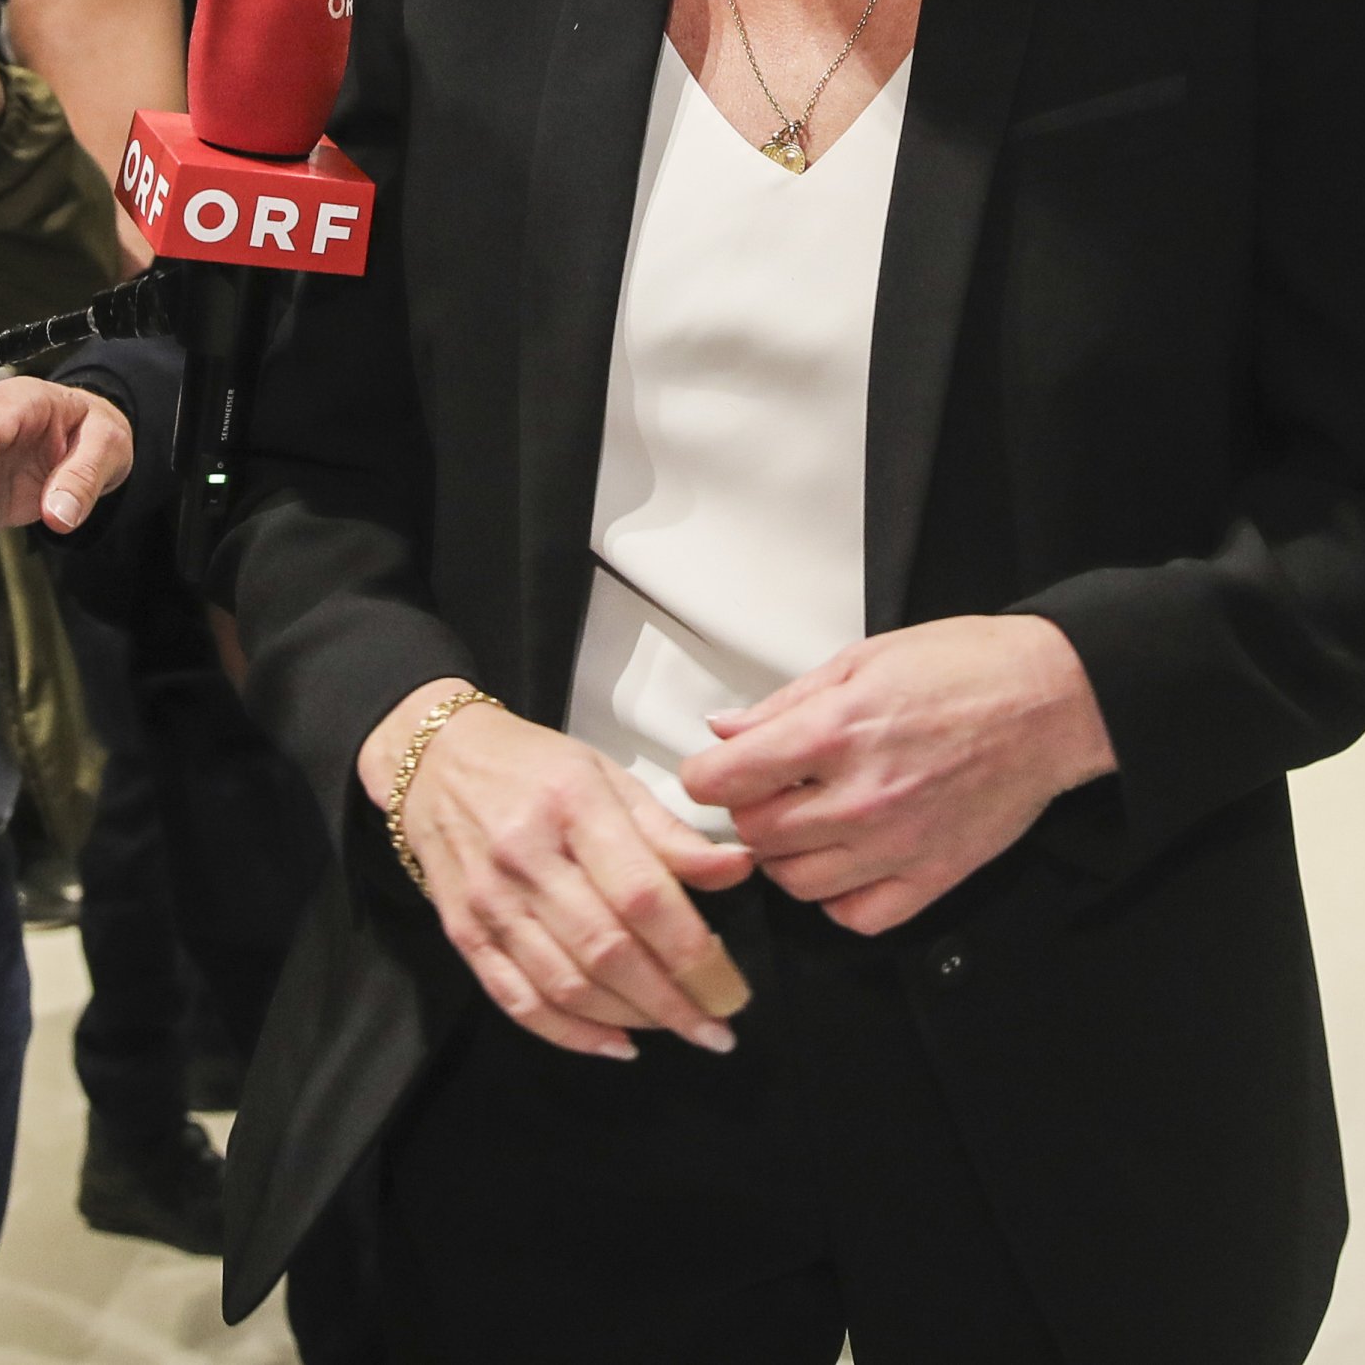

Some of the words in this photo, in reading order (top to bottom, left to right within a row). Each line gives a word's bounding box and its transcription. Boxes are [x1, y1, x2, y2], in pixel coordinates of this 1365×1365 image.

[123, 139, 170, 227] ORF
[183, 188, 360, 255] ORF
[221, 388, 235, 442] SENNHEISER
